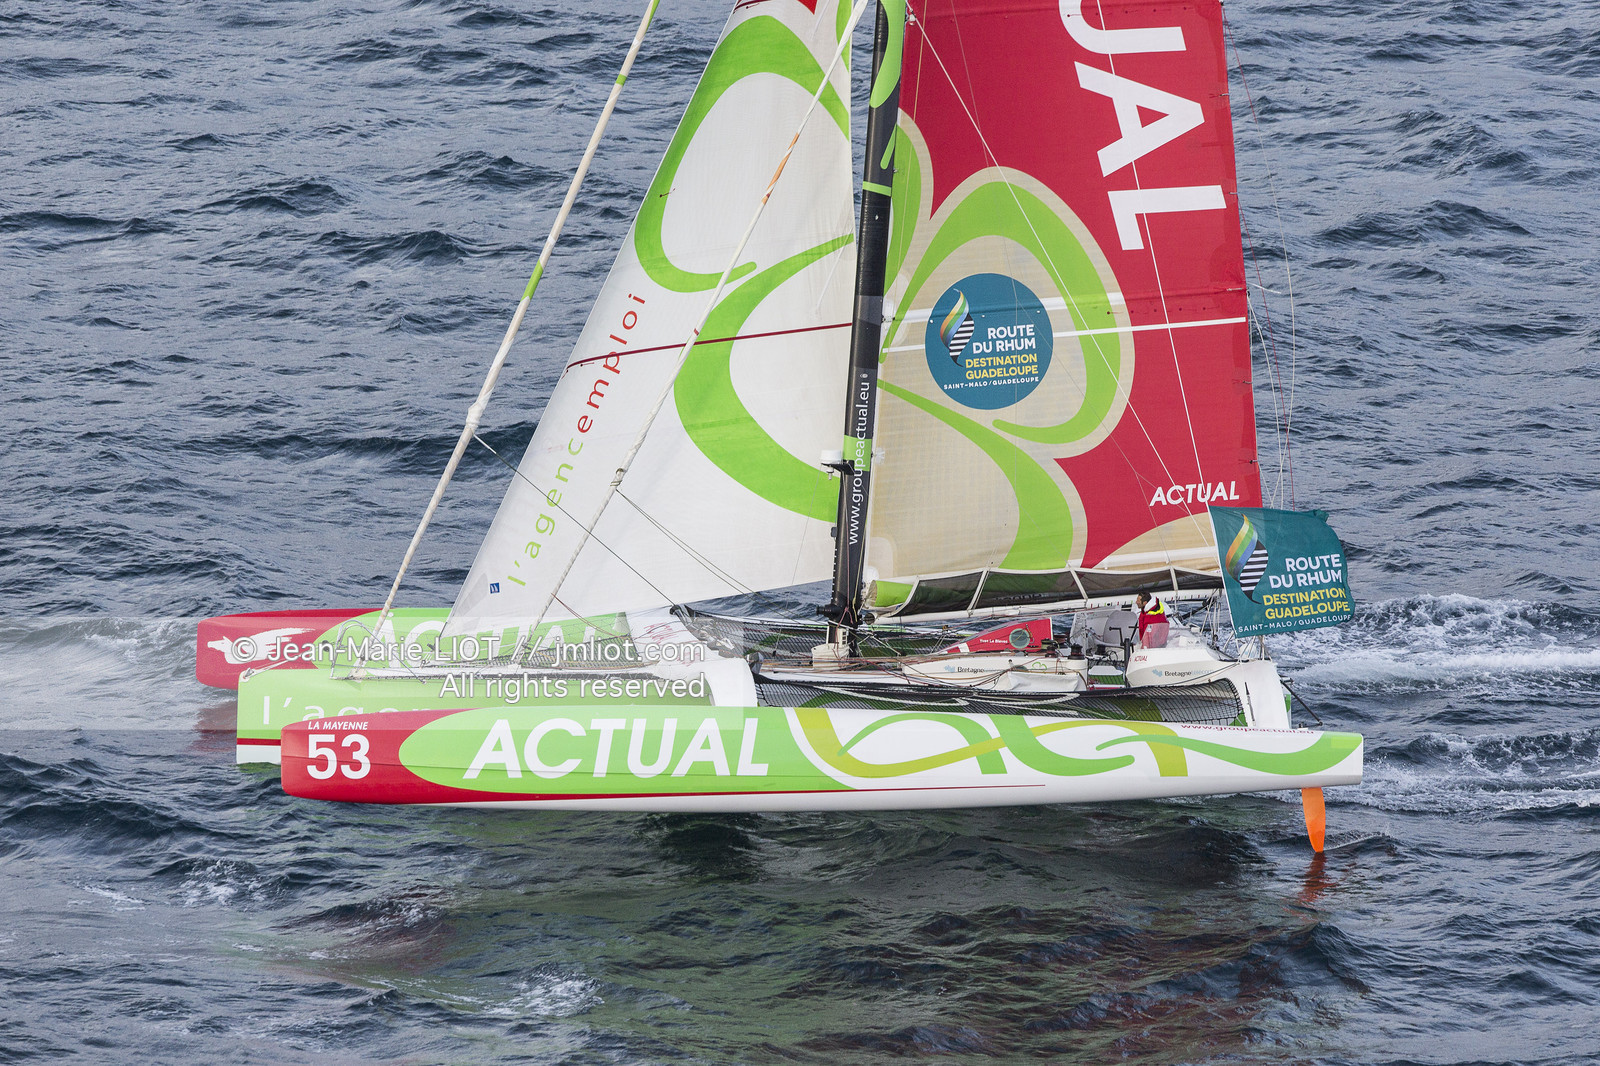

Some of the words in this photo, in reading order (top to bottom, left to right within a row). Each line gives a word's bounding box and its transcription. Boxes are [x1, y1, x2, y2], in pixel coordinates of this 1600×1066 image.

[987, 324, 1035, 340] ROUTE
[972, 342, 993, 355] DU
[995, 337, 1036, 353] RHUM
[965, 353, 1038, 369] DESTINATION
[965, 365, 1039, 380] GUADELOUPE
[848, 381, 870, 545] www.groupeactual.eu
[1149, 481, 1240, 507] ACTUAL
[1285, 553, 1342, 572] ROUTE
[1268, 575, 1293, 589] DU
[1296, 569, 1342, 587] RHUM
[1262, 587, 1346, 606] DESTINATION
[1265, 601, 1351, 620] GUADELOUPE
[307, 721, 320, 730] LA
[322, 721, 369, 730] MAYENNE
[306, 733, 371, 780] 53
[462, 717, 769, 779] ACTUAL
